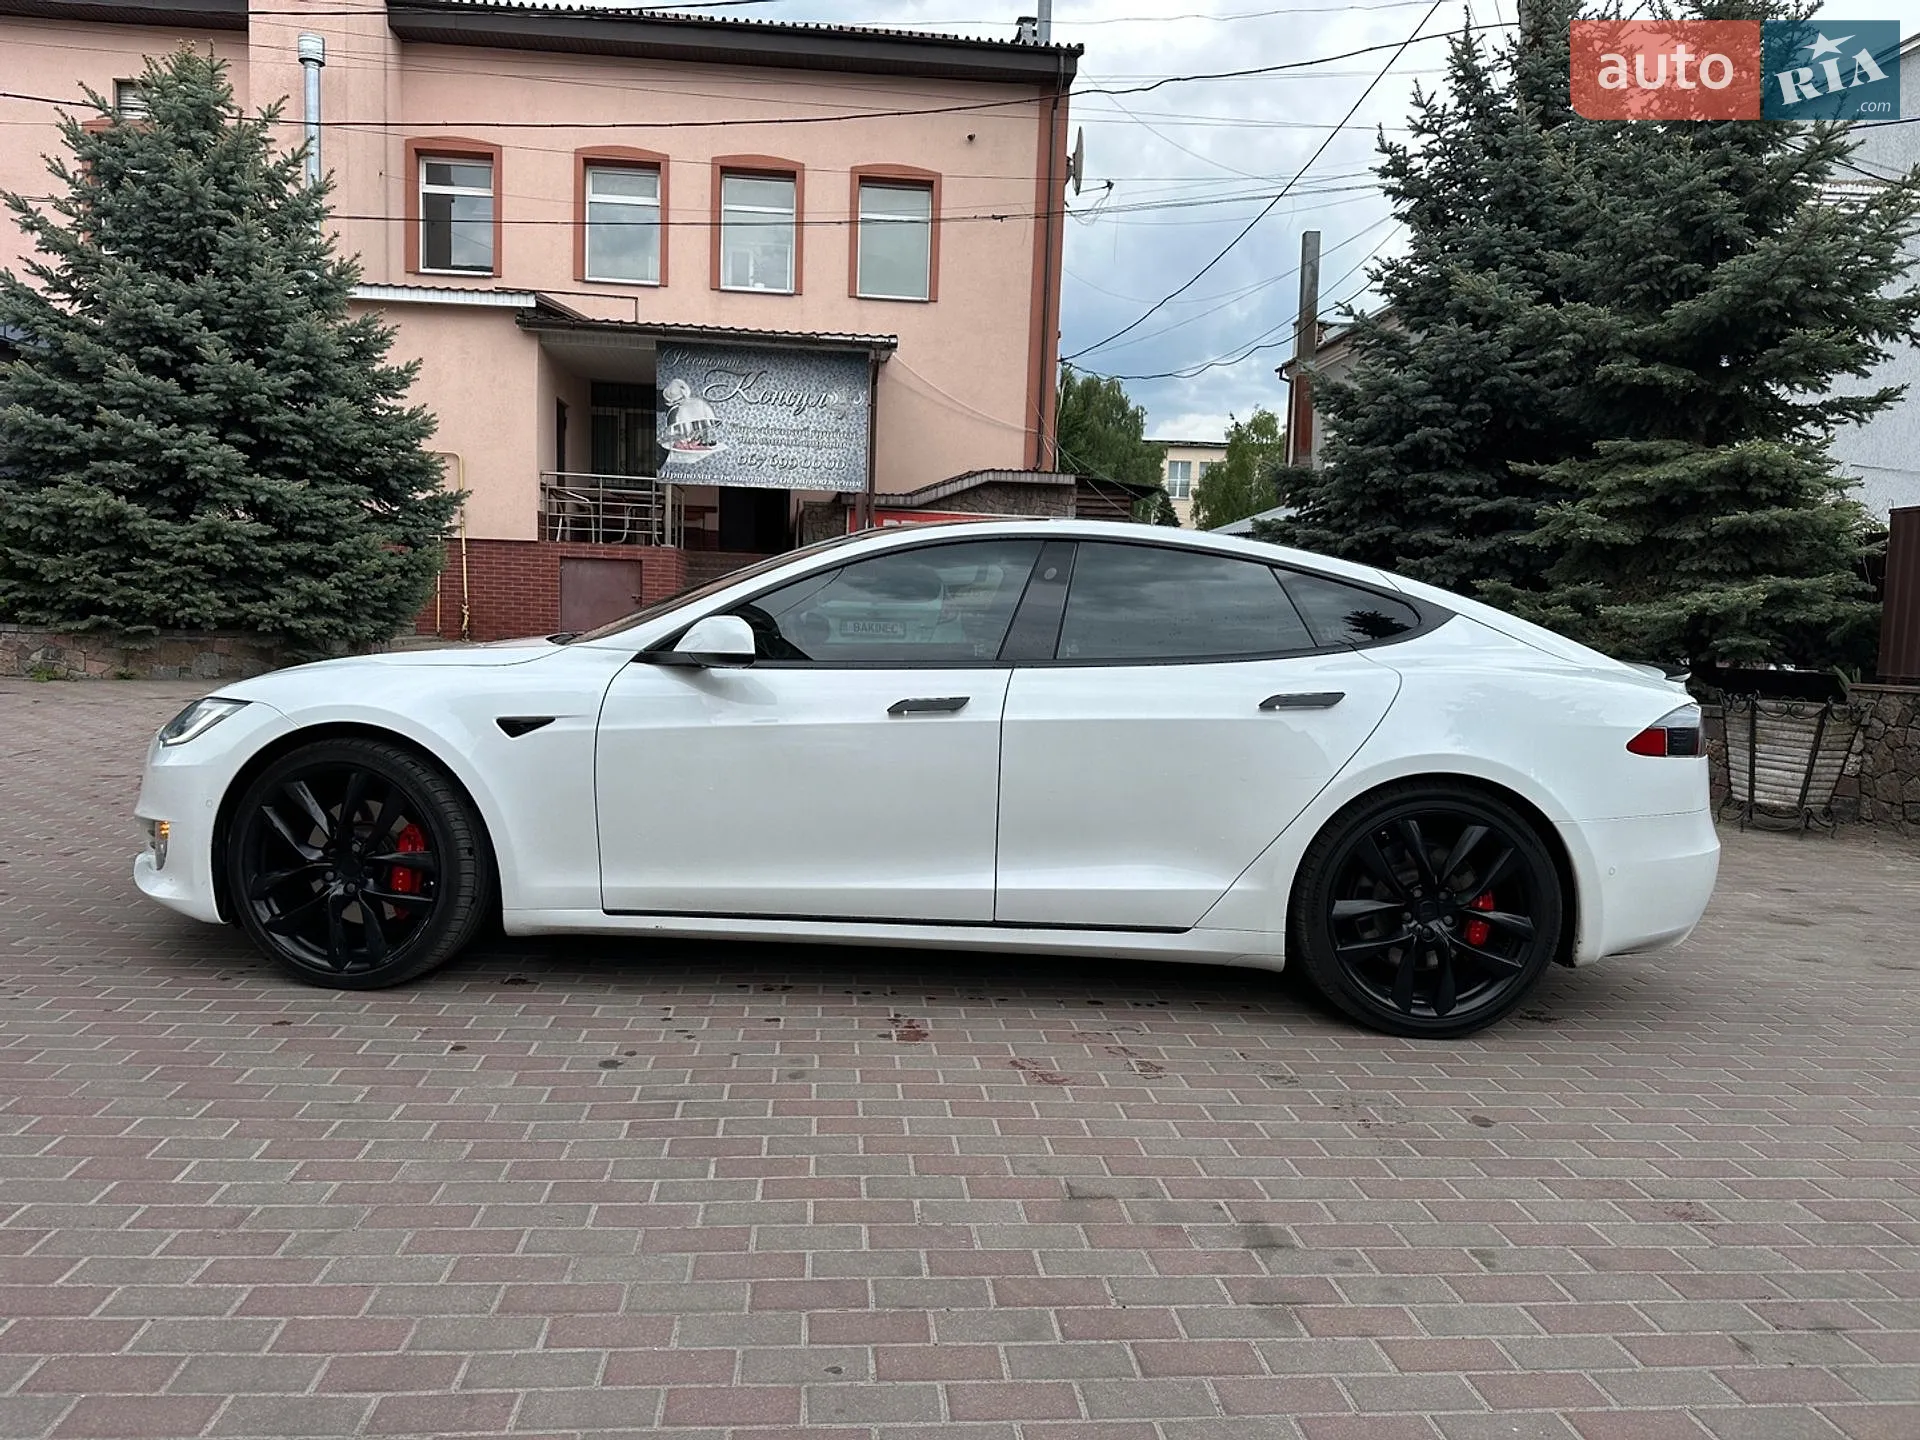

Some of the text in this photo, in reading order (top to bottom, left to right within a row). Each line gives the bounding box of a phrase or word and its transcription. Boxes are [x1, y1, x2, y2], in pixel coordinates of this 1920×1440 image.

[662, 346, 742, 370] Ресторан
[737, 454, 848, 471] 067 699 00 00
